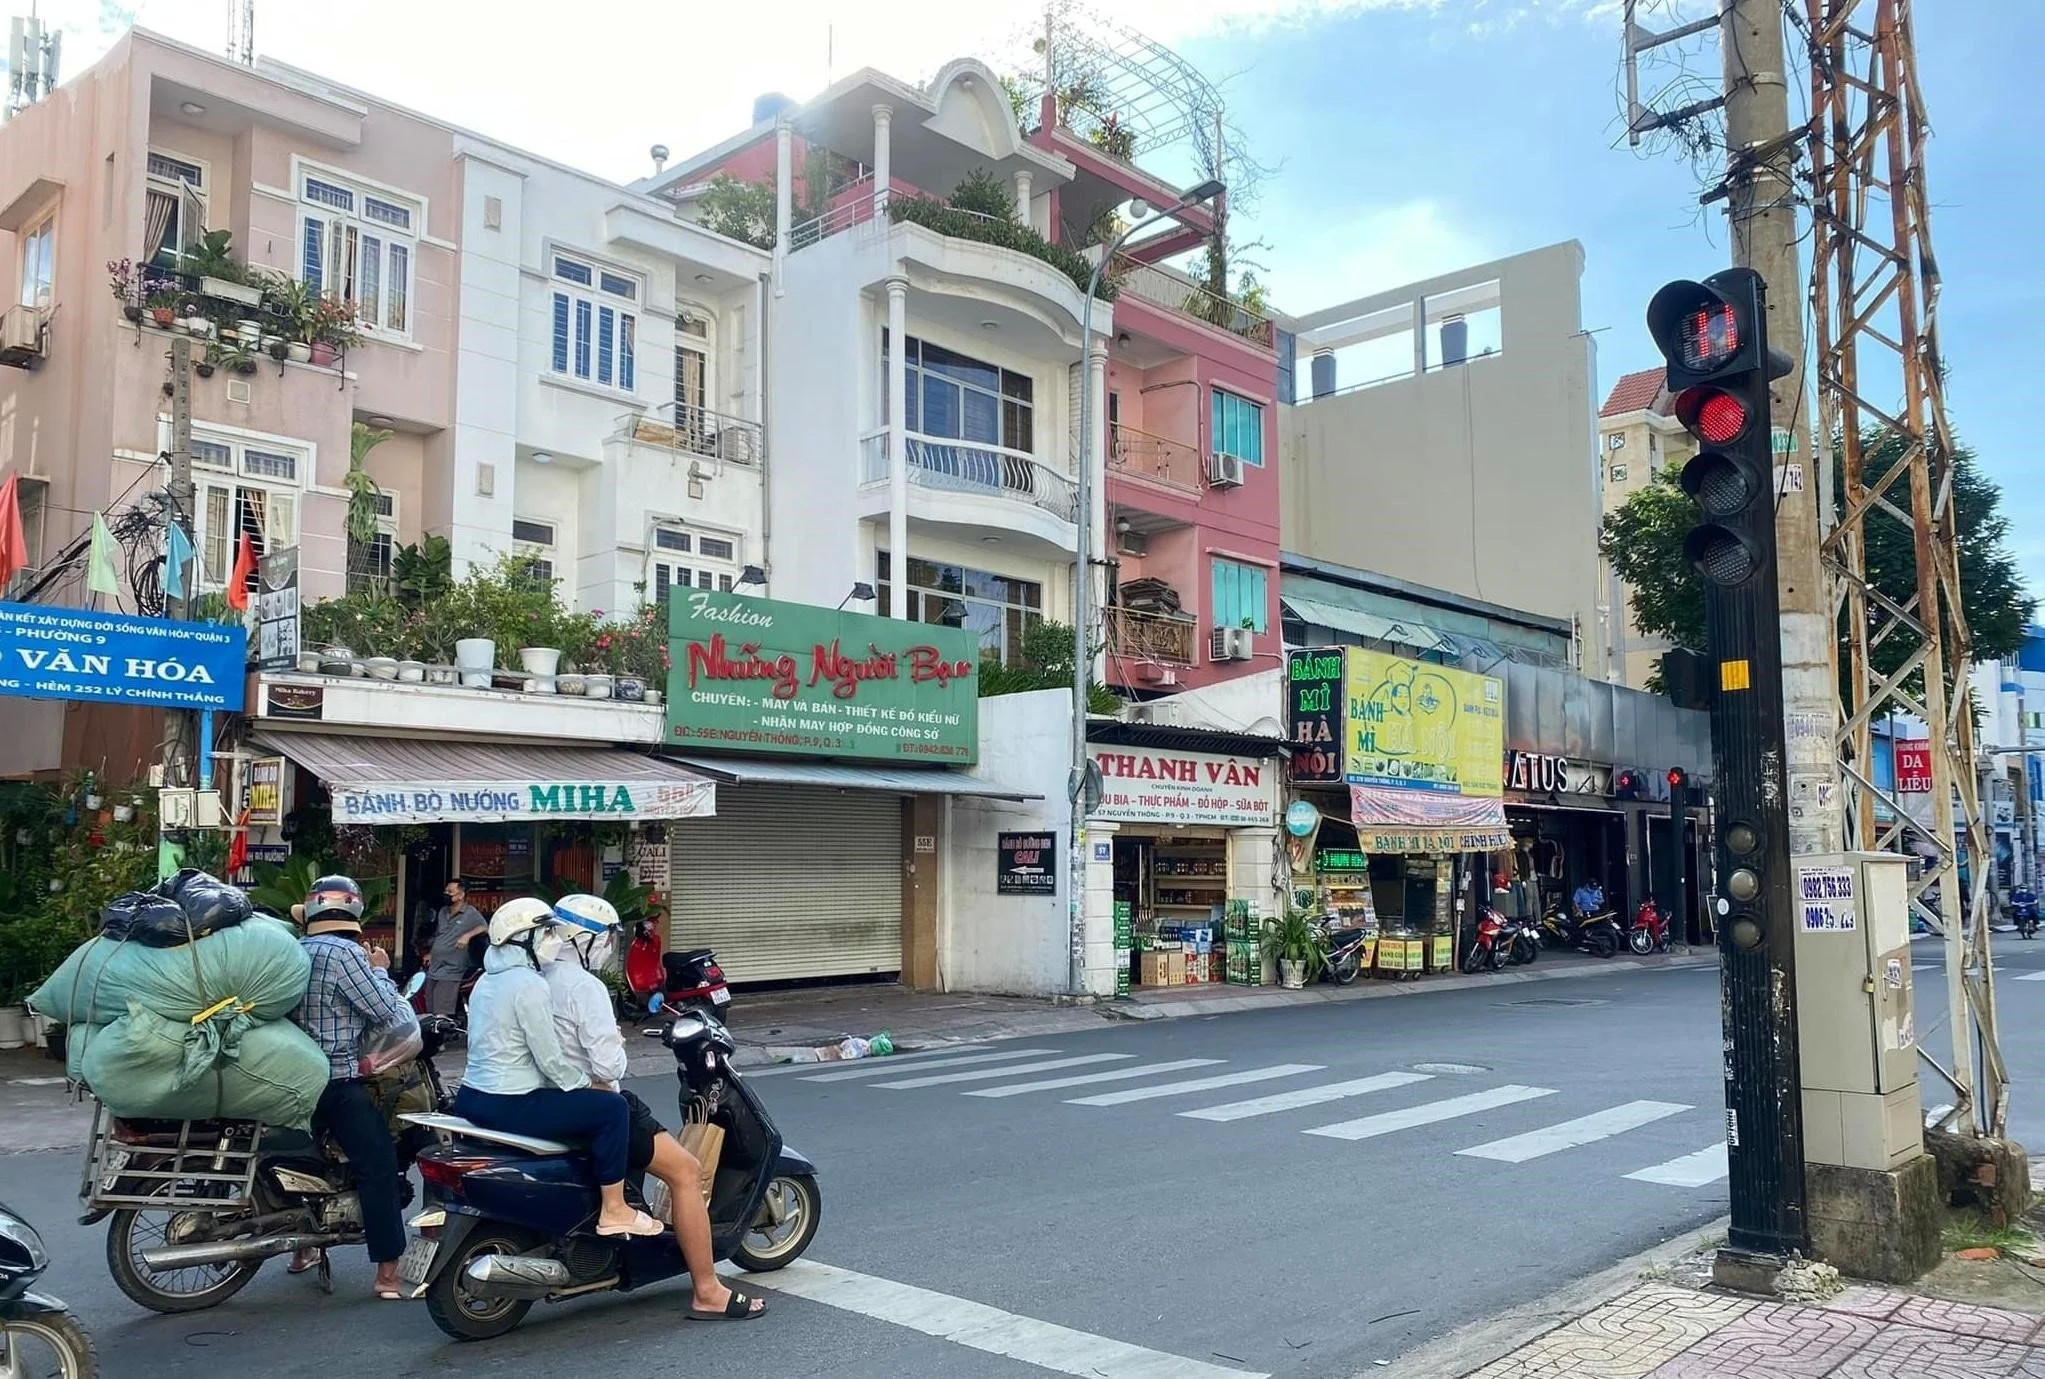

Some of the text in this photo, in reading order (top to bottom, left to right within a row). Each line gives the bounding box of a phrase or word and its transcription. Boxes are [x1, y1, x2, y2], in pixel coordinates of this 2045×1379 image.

[687, 592, 774, 629] Fashion
[15, 628, 106, 645] PHƯỜNG 9
[16, 612, 37, 623] KẾT
[38, 615, 59, 626] XÂY
[61, 618, 93, 630] DỰNG
[116, 622, 144, 635] SỐNG
[146, 626, 167, 637] VĂN
[195, 632, 223, 644] QUẬN
[224, 635, 231, 643] 3
[15, 648, 216, 684] VĂN HÓA
[687, 632, 973, 699] Những Người Bạn
[1291, 652, 1340, 680] BÁNH
[74, 685, 102, 694] 252
[125, 689, 173, 700] CHÍNH
[175, 691, 225, 704] THẮNG
[1350, 694, 1384, 723] BÁNH
[762, 698, 790, 710] MAY
[793, 701, 808, 712] VÀ
[812, 702, 837, 714] BÁN
[845, 704, 878, 718] THIẾT
[881, 707, 897, 720] KẾ
[899, 709, 915, 722] ĐỒ
[761, 714, 796, 731] NHẬN
[799, 719, 826, 732] MAY
[828, 721, 854, 735] HỢP
[856, 721, 889, 736] ĐỒNG
[890, 726, 921, 739] CÔNG
[1297, 715, 1333, 742] HÀ
[1357, 726, 1376, 753] MÌ
[1096, 753, 1261, 787] THANH VÂN
[1294, 746, 1336, 779] NỘI
[1505, 751, 1568, 792] ATUS
[1902, 755, 1924, 768] DA
[344, 784, 637, 816] BÁNH BÒ NƯỚNG MIHA
[1113, 794, 1129, 806] BIA
[1138, 795, 1162, 809] THỰC
[1163, 792, 1190, 808] PHẨM
[1197, 794, 1210, 808] ĐỒ
[1211, 797, 1229, 811] HỘP
